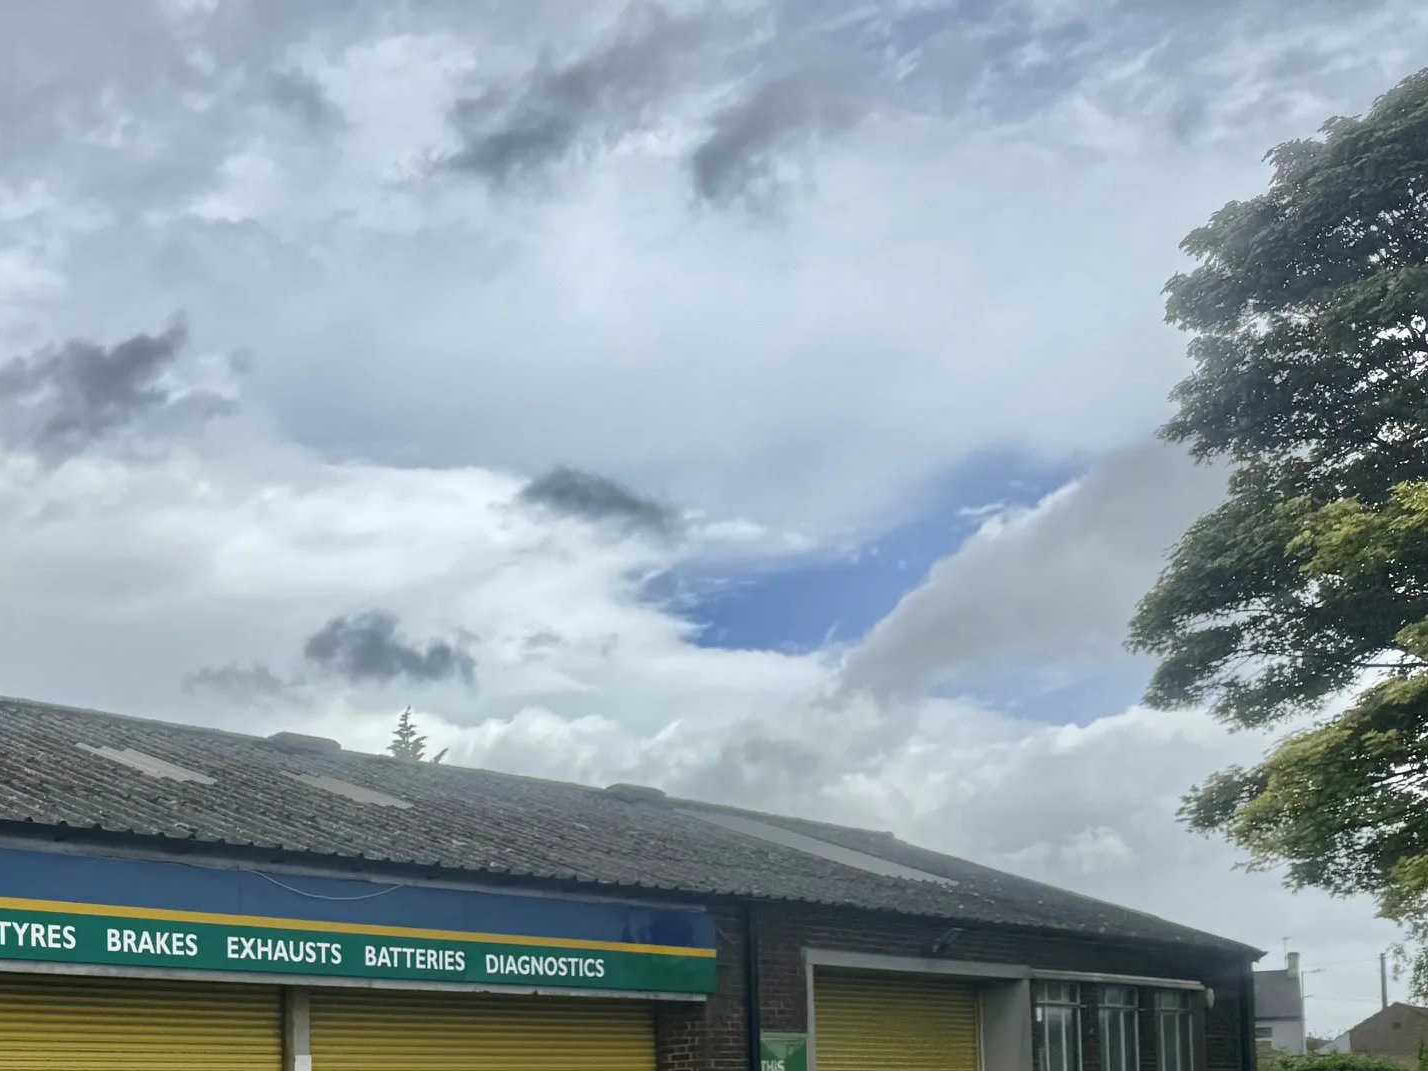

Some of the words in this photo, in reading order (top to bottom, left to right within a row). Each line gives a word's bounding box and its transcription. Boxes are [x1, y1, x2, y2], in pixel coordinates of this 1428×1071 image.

[106, 928, 199, 957] BRAKES
[227, 936, 342, 965] EXHAUSTS
[364, 945, 466, 972] BATTERIES
[485, 954, 605, 979] DIAGNOSTICS
